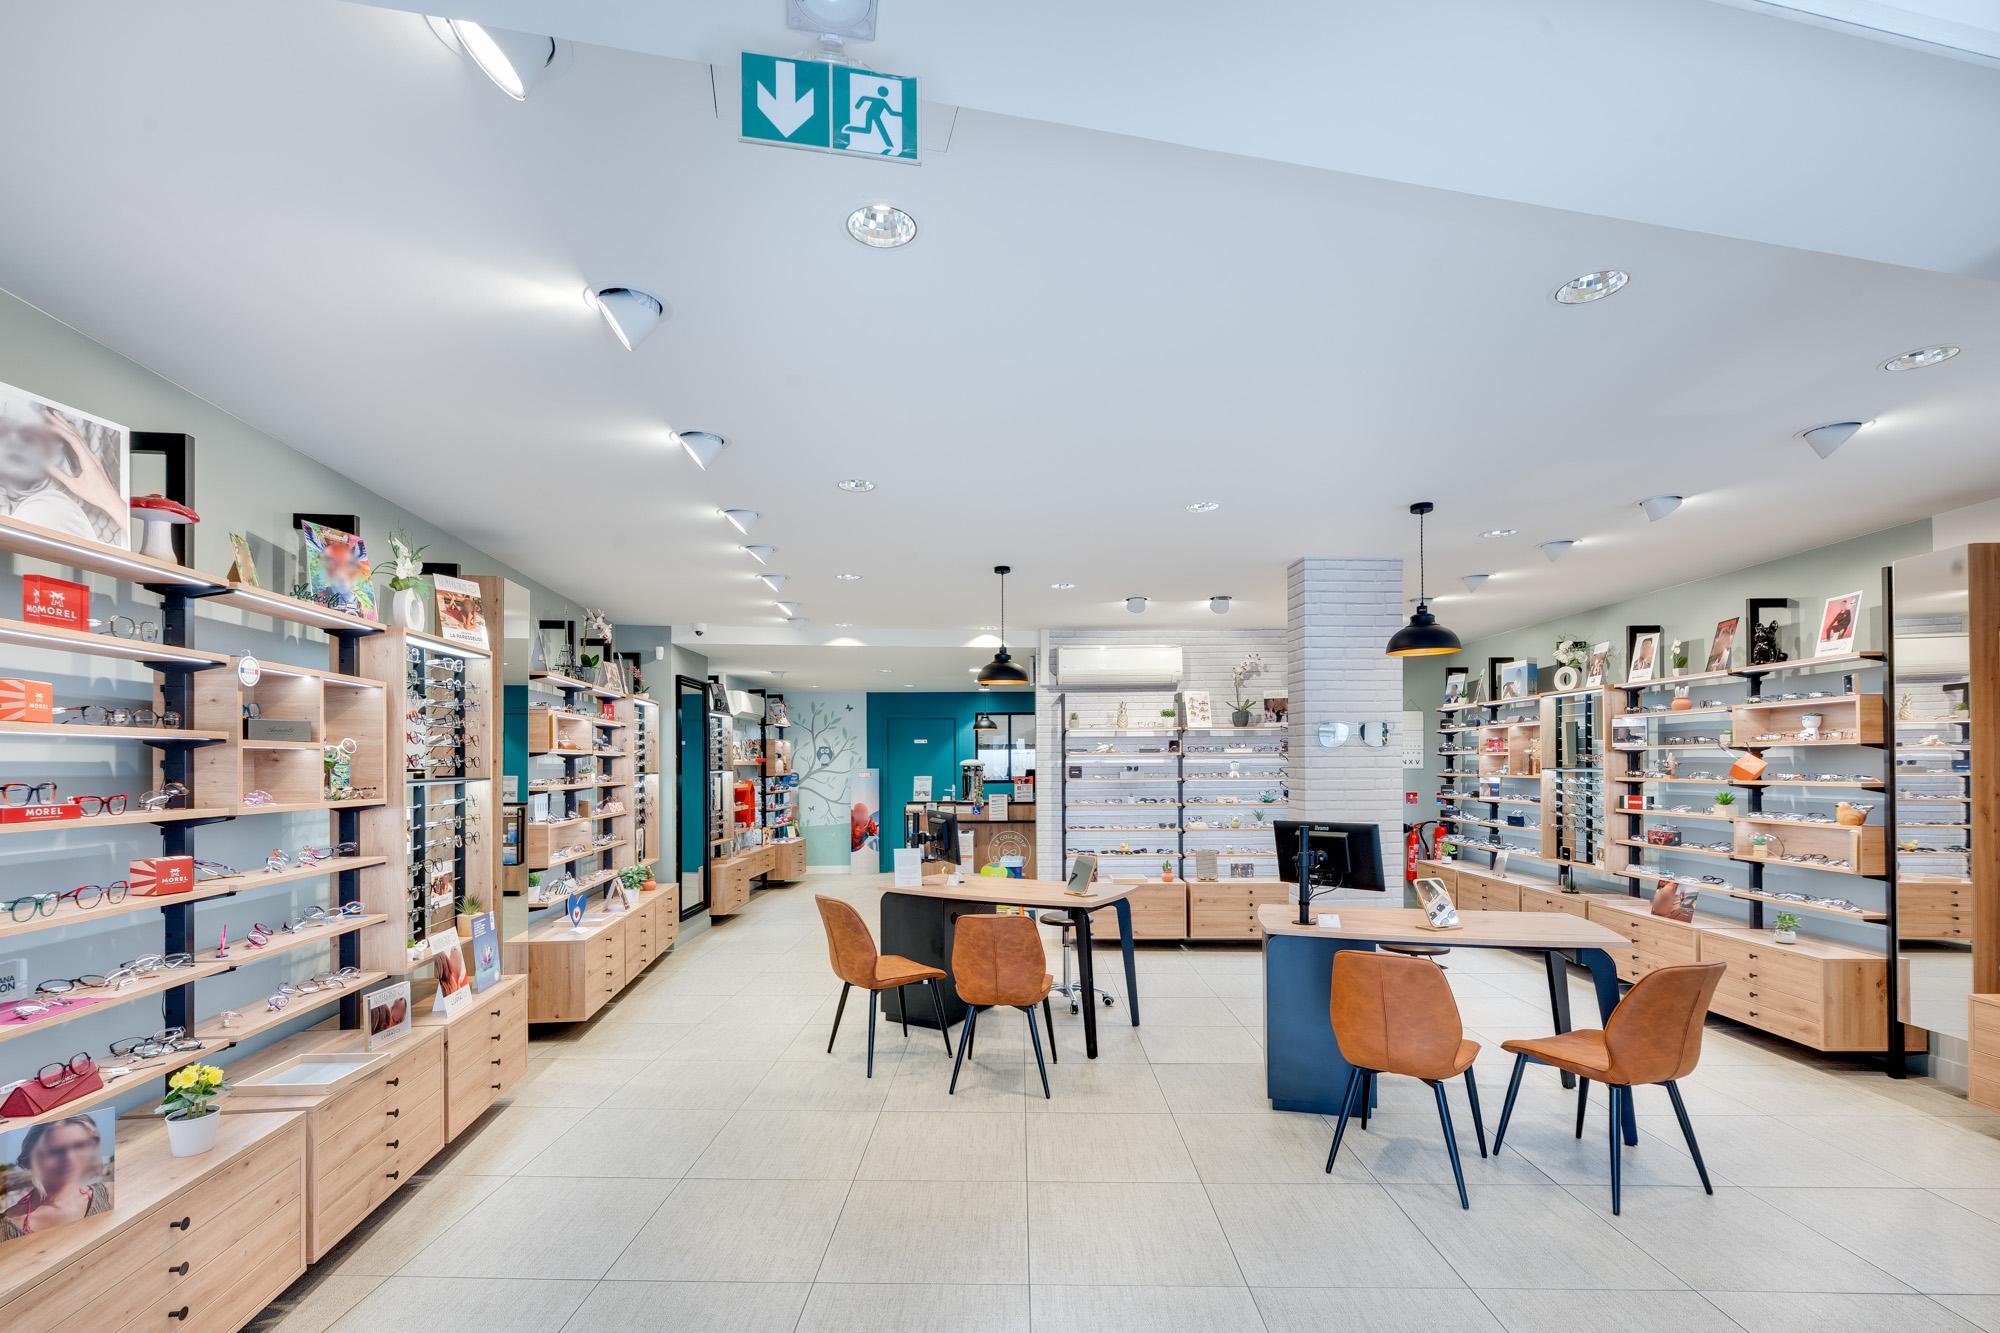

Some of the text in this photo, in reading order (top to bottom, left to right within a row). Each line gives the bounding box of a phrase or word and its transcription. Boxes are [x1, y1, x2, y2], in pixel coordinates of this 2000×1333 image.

[39, 605, 78, 620] MOREL
[25, 807, 64, 817] MOREL
[161, 876, 189, 885] MOREL
